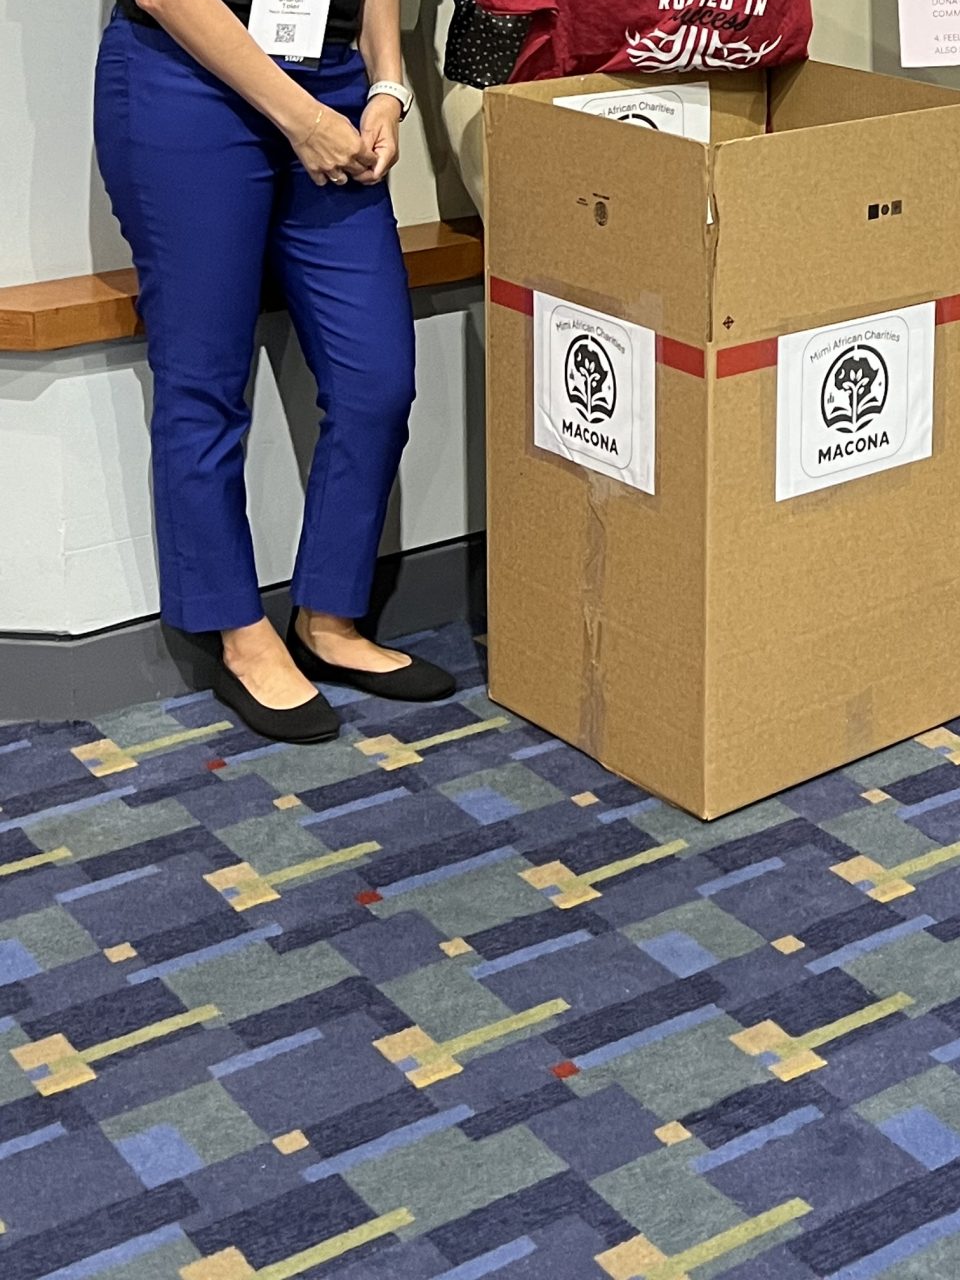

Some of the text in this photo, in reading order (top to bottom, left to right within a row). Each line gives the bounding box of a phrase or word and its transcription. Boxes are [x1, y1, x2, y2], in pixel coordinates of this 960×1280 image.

[934, 46, 957, 54] ALSO
[943, 33, 960, 42] FEEL
[607, 103, 637, 116] African
[638, 101, 675, 116] Charities
[555, 320, 626, 355] Mimi African Charities
[809, 330, 901, 363] Mimi African Charities
[562, 419, 619, 456] MACONA
[818, 431, 890, 465] MACONA
